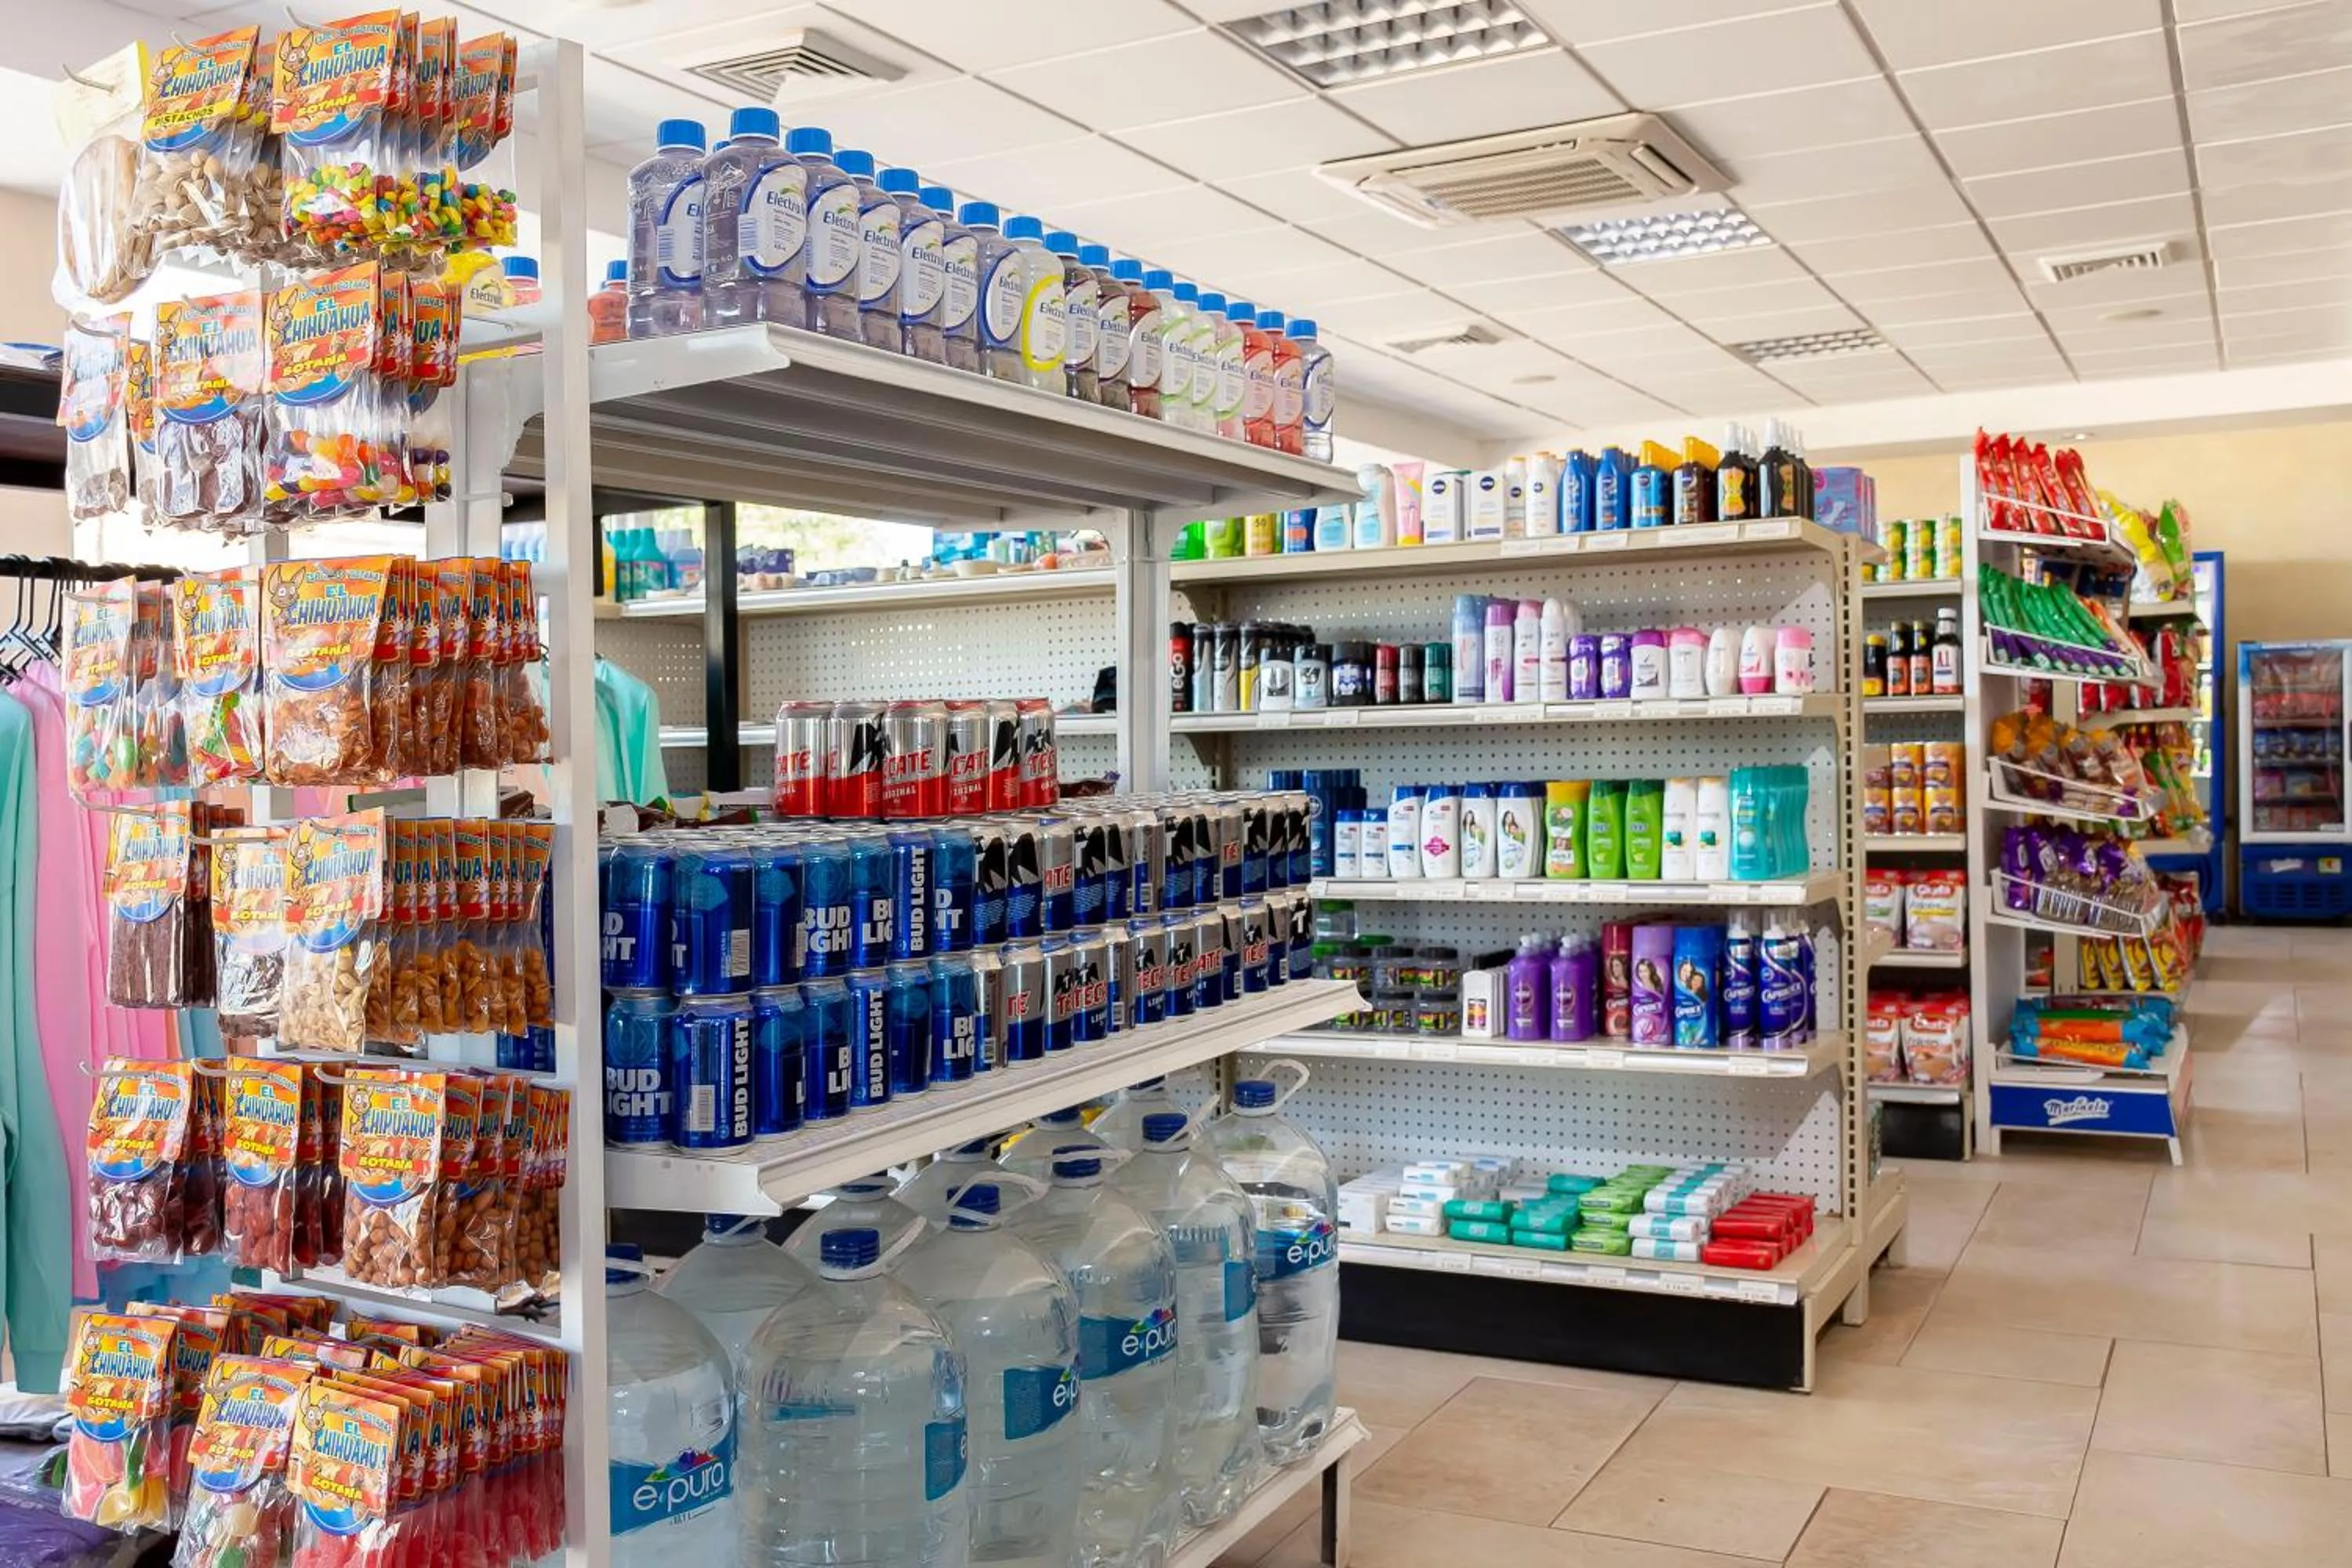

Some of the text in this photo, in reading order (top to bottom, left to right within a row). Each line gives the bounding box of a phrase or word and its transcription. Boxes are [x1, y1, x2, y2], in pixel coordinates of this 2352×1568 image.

[332, 42, 353, 56] EL
[299, 45, 386, 86] CHIHUAHUA
[161, 60, 241, 97] CHIHUAHUA
[154, 106, 214, 125] PISTACHOS
[315, 297, 338, 313] EL
[201, 320, 224, 336] EL
[282, 301, 372, 345] CHIHUAHUA
[168, 327, 257, 362] CHIHUAHUA
[282, 352, 348, 376] BOTANA
[325, 583, 347, 598] EL
[287, 593, 377, 626] CHIHUAHUA
[884, 747, 935, 779] CATE
[910, 846, 925, 951] BUD LIGHT
[804, 906, 851, 930] BUD
[804, 928, 852, 953] IGH
[869, 989, 884, 1098] BUD LIGHT
[606, 1066, 661, 1092] BUD
[735, 1018, 749, 1138] BUD LIGHT
[260, 1084, 275, 1098] EL
[607, 1091, 672, 1116] IGHT
[107, 1093, 182, 1120] CHIHAHUA
[236, 1094, 296, 1126] CHIHUAHUA
[390, 1097, 409, 1111] EL
[361, 1109, 436, 1138] CHIHUAHUA
[235, 1138, 276, 1155] BOTANA
[358, 1156, 415, 1171] BOTANA
[118, 1340, 133, 1353] EL
[90, 1350, 156, 1381] CHIHUAHUA
[87, 1396, 134, 1410] BOTANA
[250, 1387, 265, 1400] EL
[216, 1399, 287, 1428] CHIHUAHUA
[343, 1419, 361, 1436] EL
[315, 1428, 387, 1470] CHIHUAHUA
[312, 1477, 363, 1501] BOTANA
